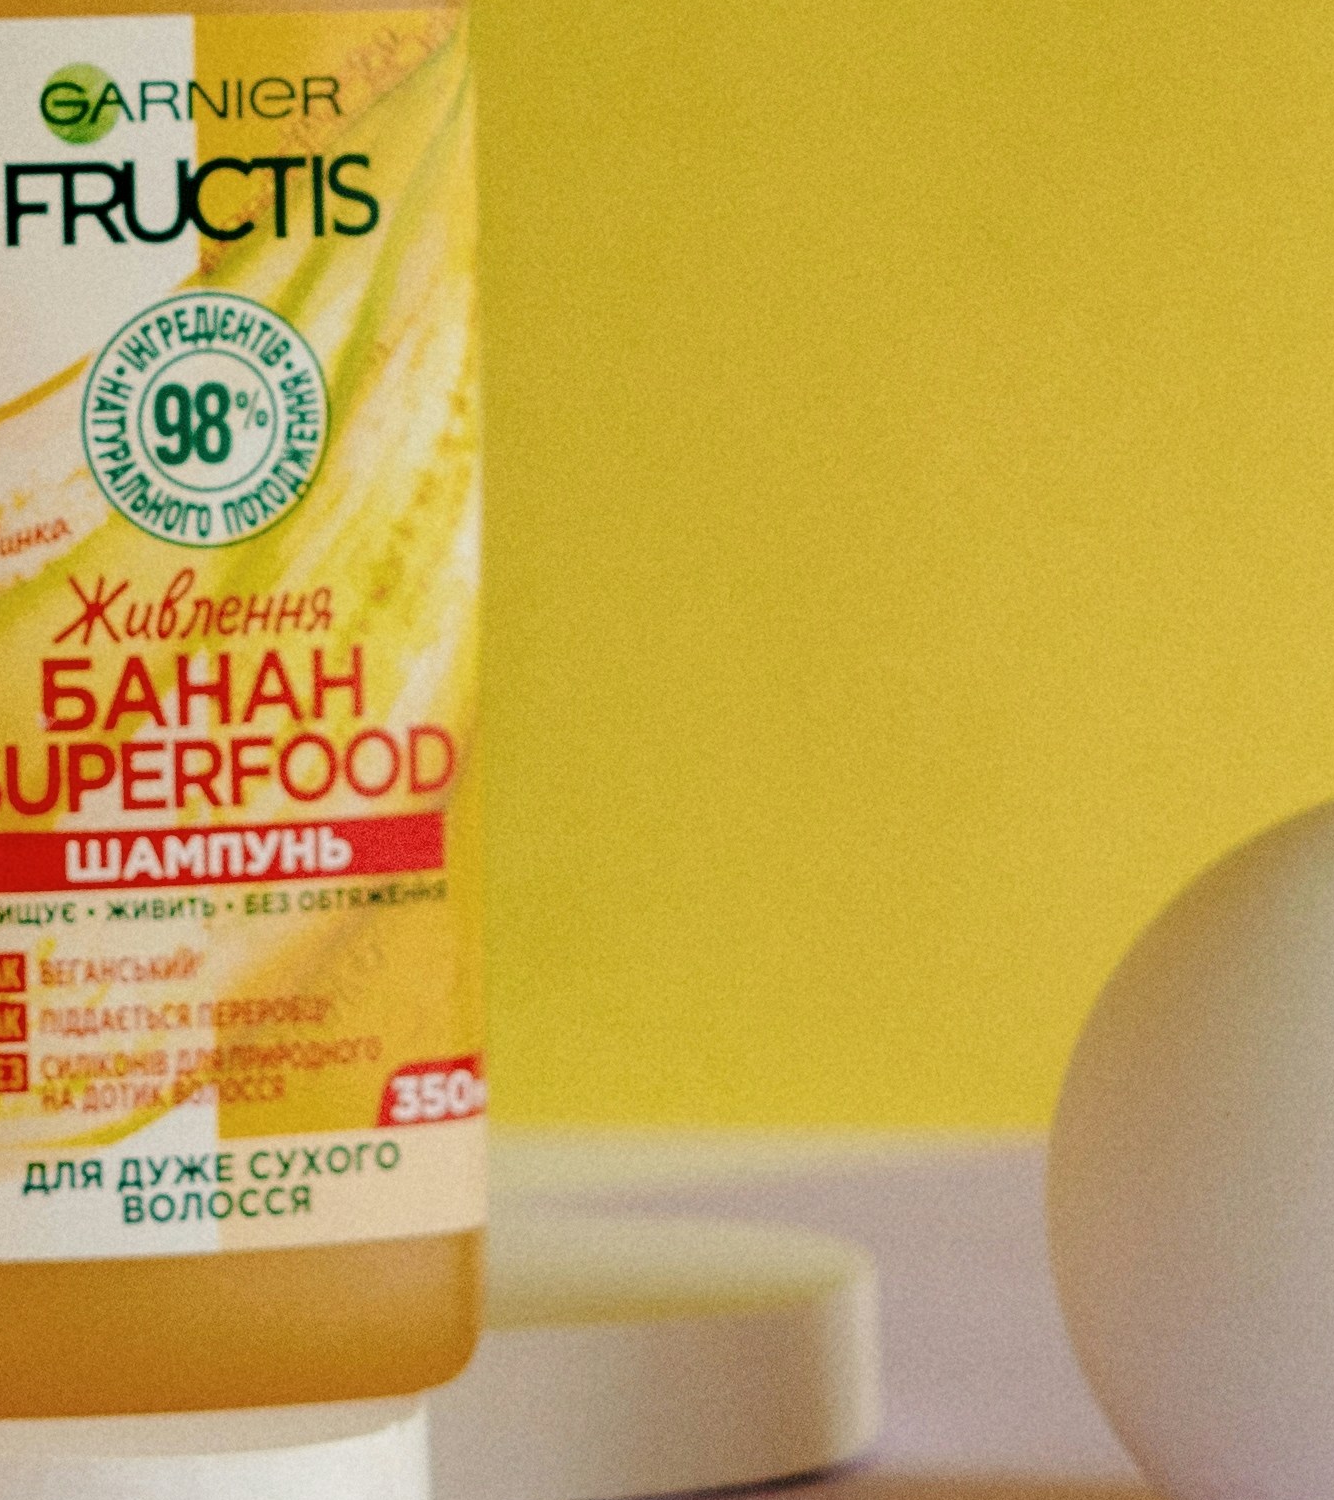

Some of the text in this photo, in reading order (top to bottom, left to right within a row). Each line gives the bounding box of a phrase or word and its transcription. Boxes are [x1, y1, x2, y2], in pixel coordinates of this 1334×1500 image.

[40, 75, 343, 127] GARNIER
[4, 153, 381, 247] FRUCTIS
[52, 567, 334, 648] Живлення
[40, 645, 365, 731] БАНАН
[66, 825, 352, 883] ШАМПУНЬ
[106, 897, 216, 923] ЖИВИТЬ
[244, 890, 290, 914] БЕЗ
[24, 1140, 400, 1195] ДЛЯ ДУЖЕ СУХОГО
[125, 1185, 311, 1224] ВОЛОССЯ
